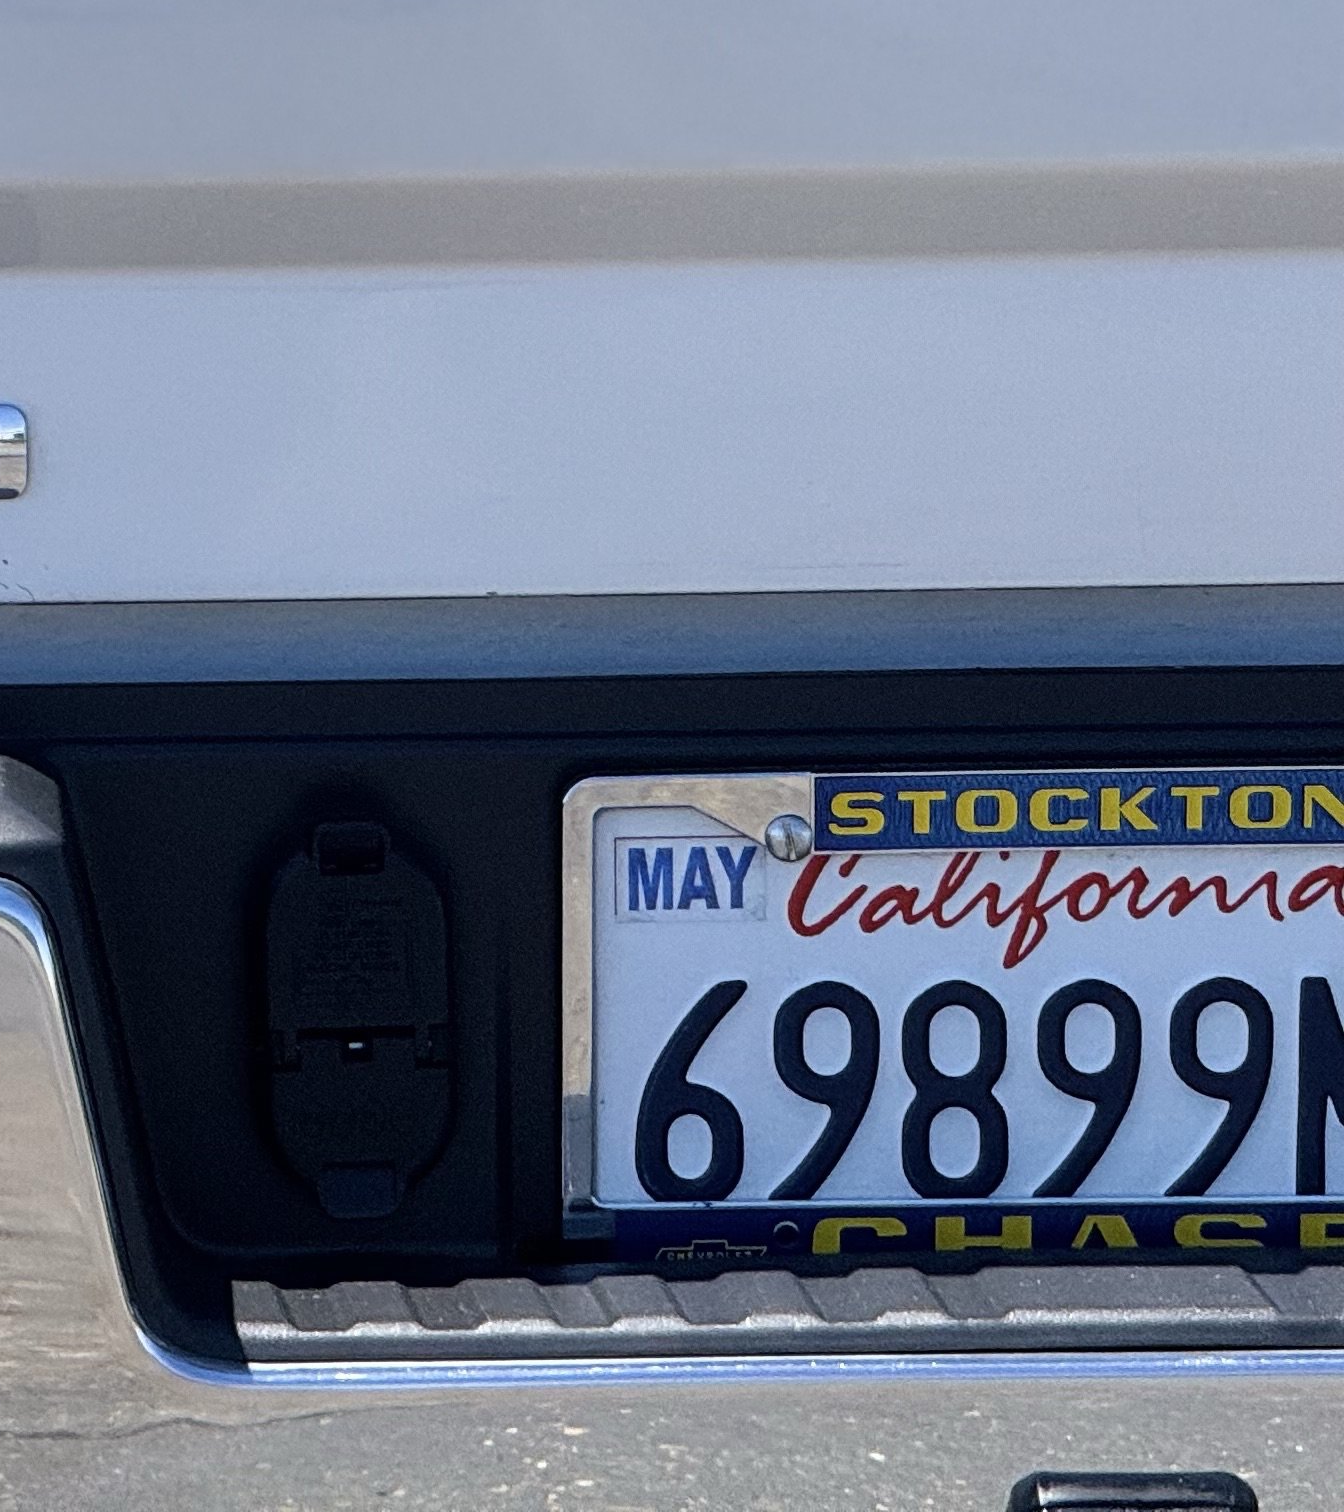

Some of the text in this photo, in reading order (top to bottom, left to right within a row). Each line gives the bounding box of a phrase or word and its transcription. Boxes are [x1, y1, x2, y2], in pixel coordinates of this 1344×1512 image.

[828, 784, 1344, 834] STOCKTON
[628, 845, 758, 911] MAY
[787, 850, 1344, 969] California
